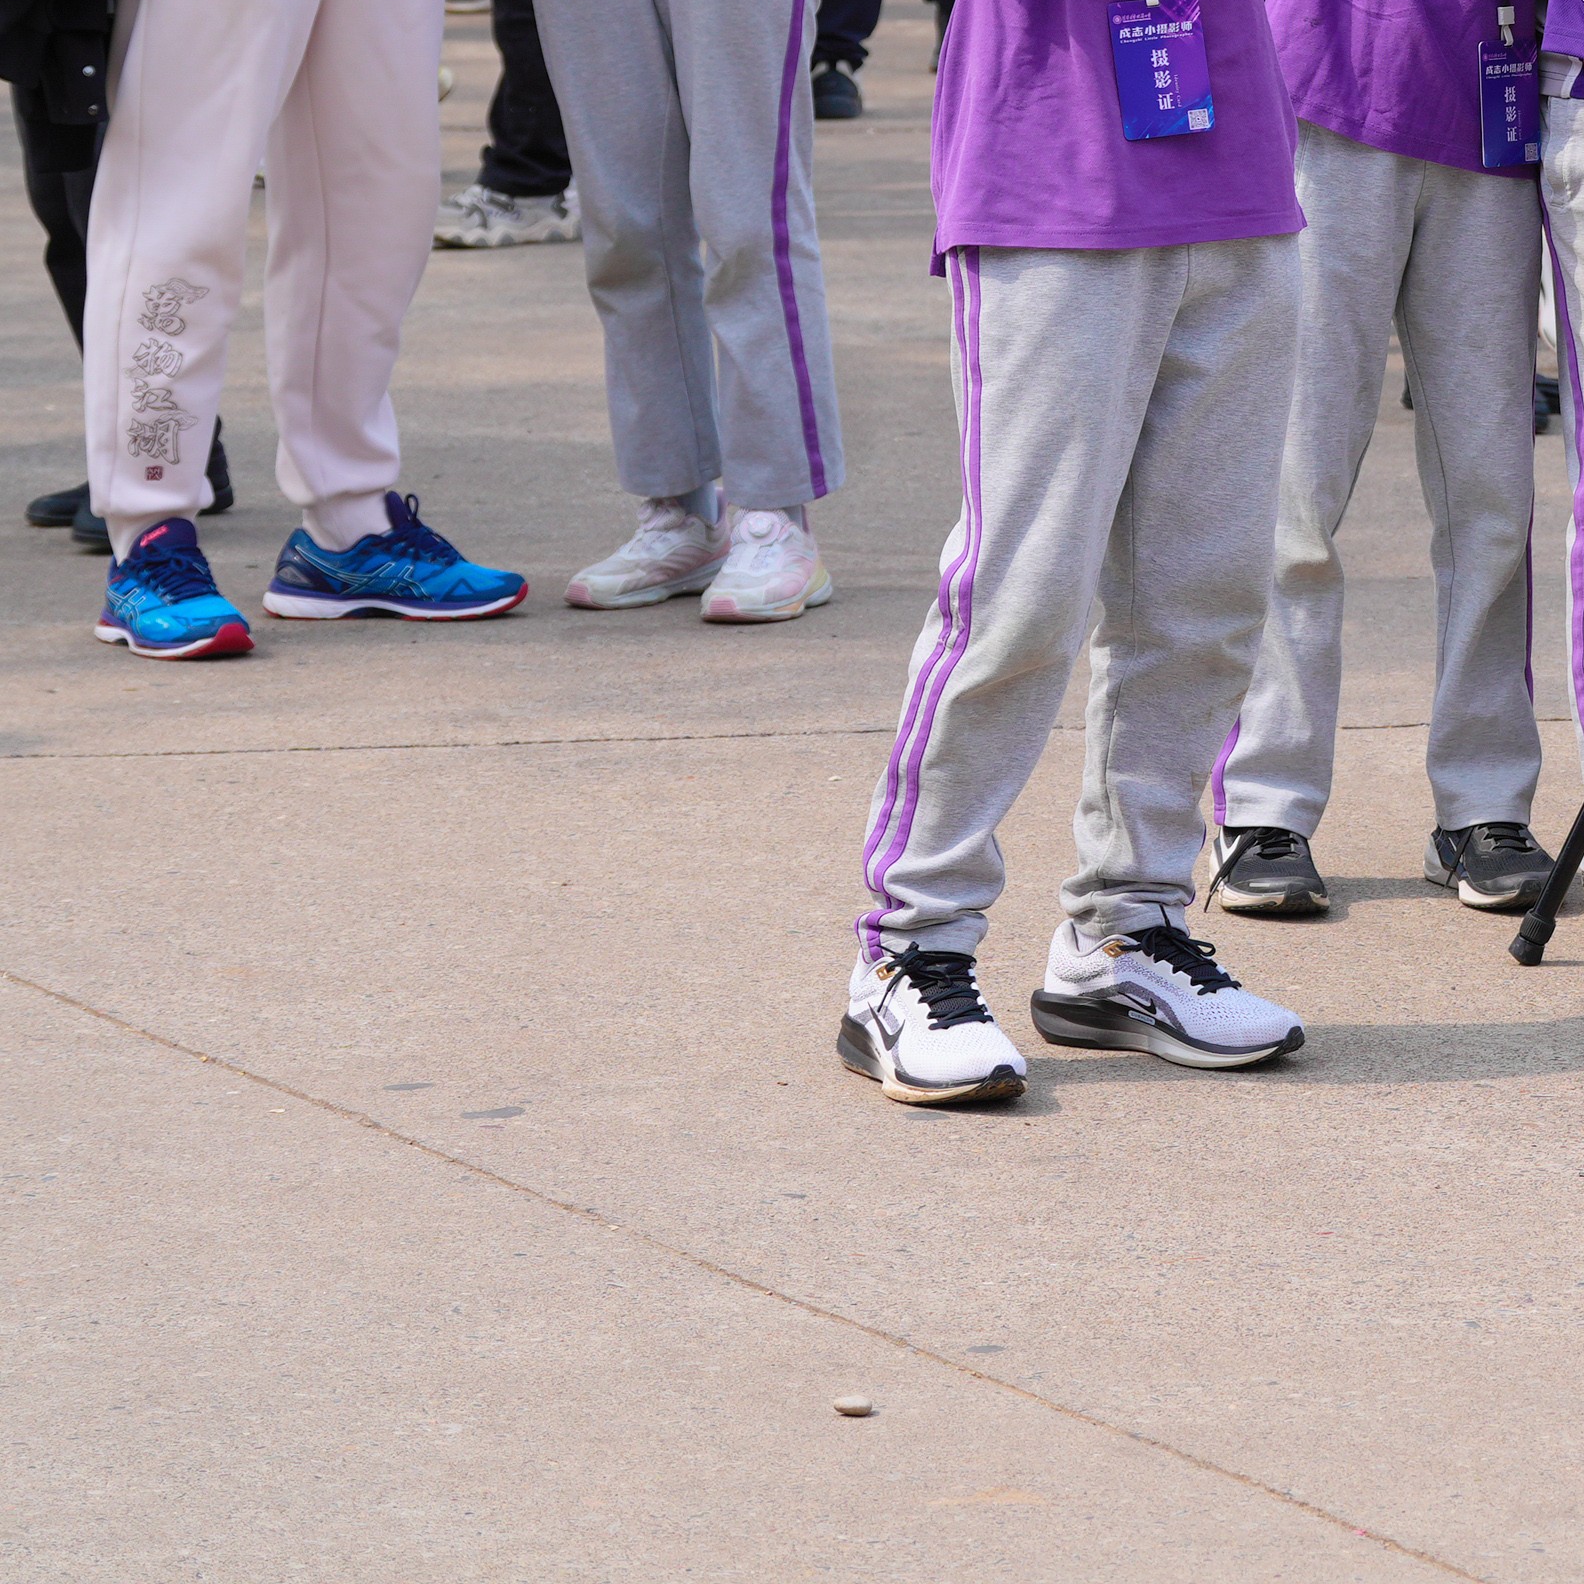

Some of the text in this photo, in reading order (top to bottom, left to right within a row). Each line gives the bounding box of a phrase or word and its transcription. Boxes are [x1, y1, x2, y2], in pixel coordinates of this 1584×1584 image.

[1119, 20, 1193, 39] 成志小摄影师
[1150, 48, 1175, 110] 摄影证
[1504, 85, 1518, 142] 摄影证
